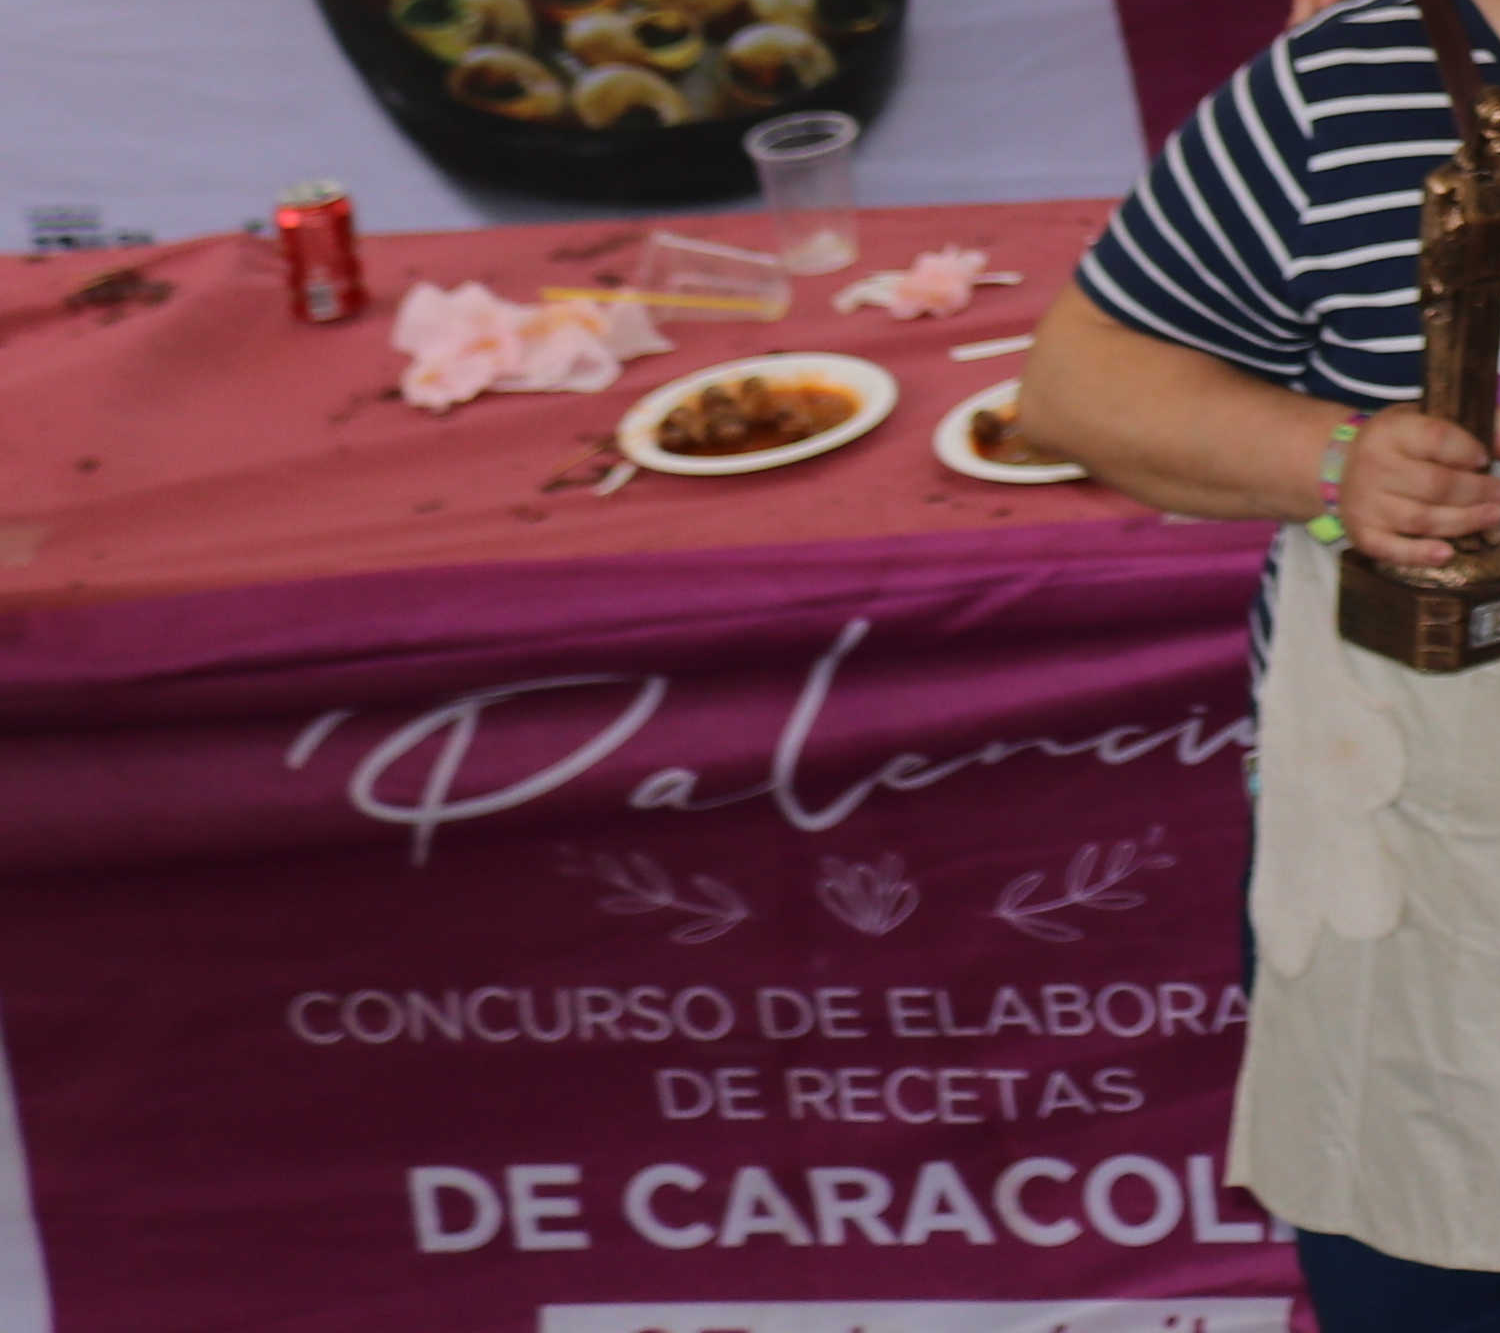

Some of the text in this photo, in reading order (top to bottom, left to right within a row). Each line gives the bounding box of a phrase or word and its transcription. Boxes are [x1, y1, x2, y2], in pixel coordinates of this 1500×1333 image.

[288, 987, 735, 1044] CONCURSO
[758, 986, 868, 1039] DE
[655, 1068, 1146, 1123] DE RECETAS
[409, 1155, 1297, 1253] DE CARACOL
